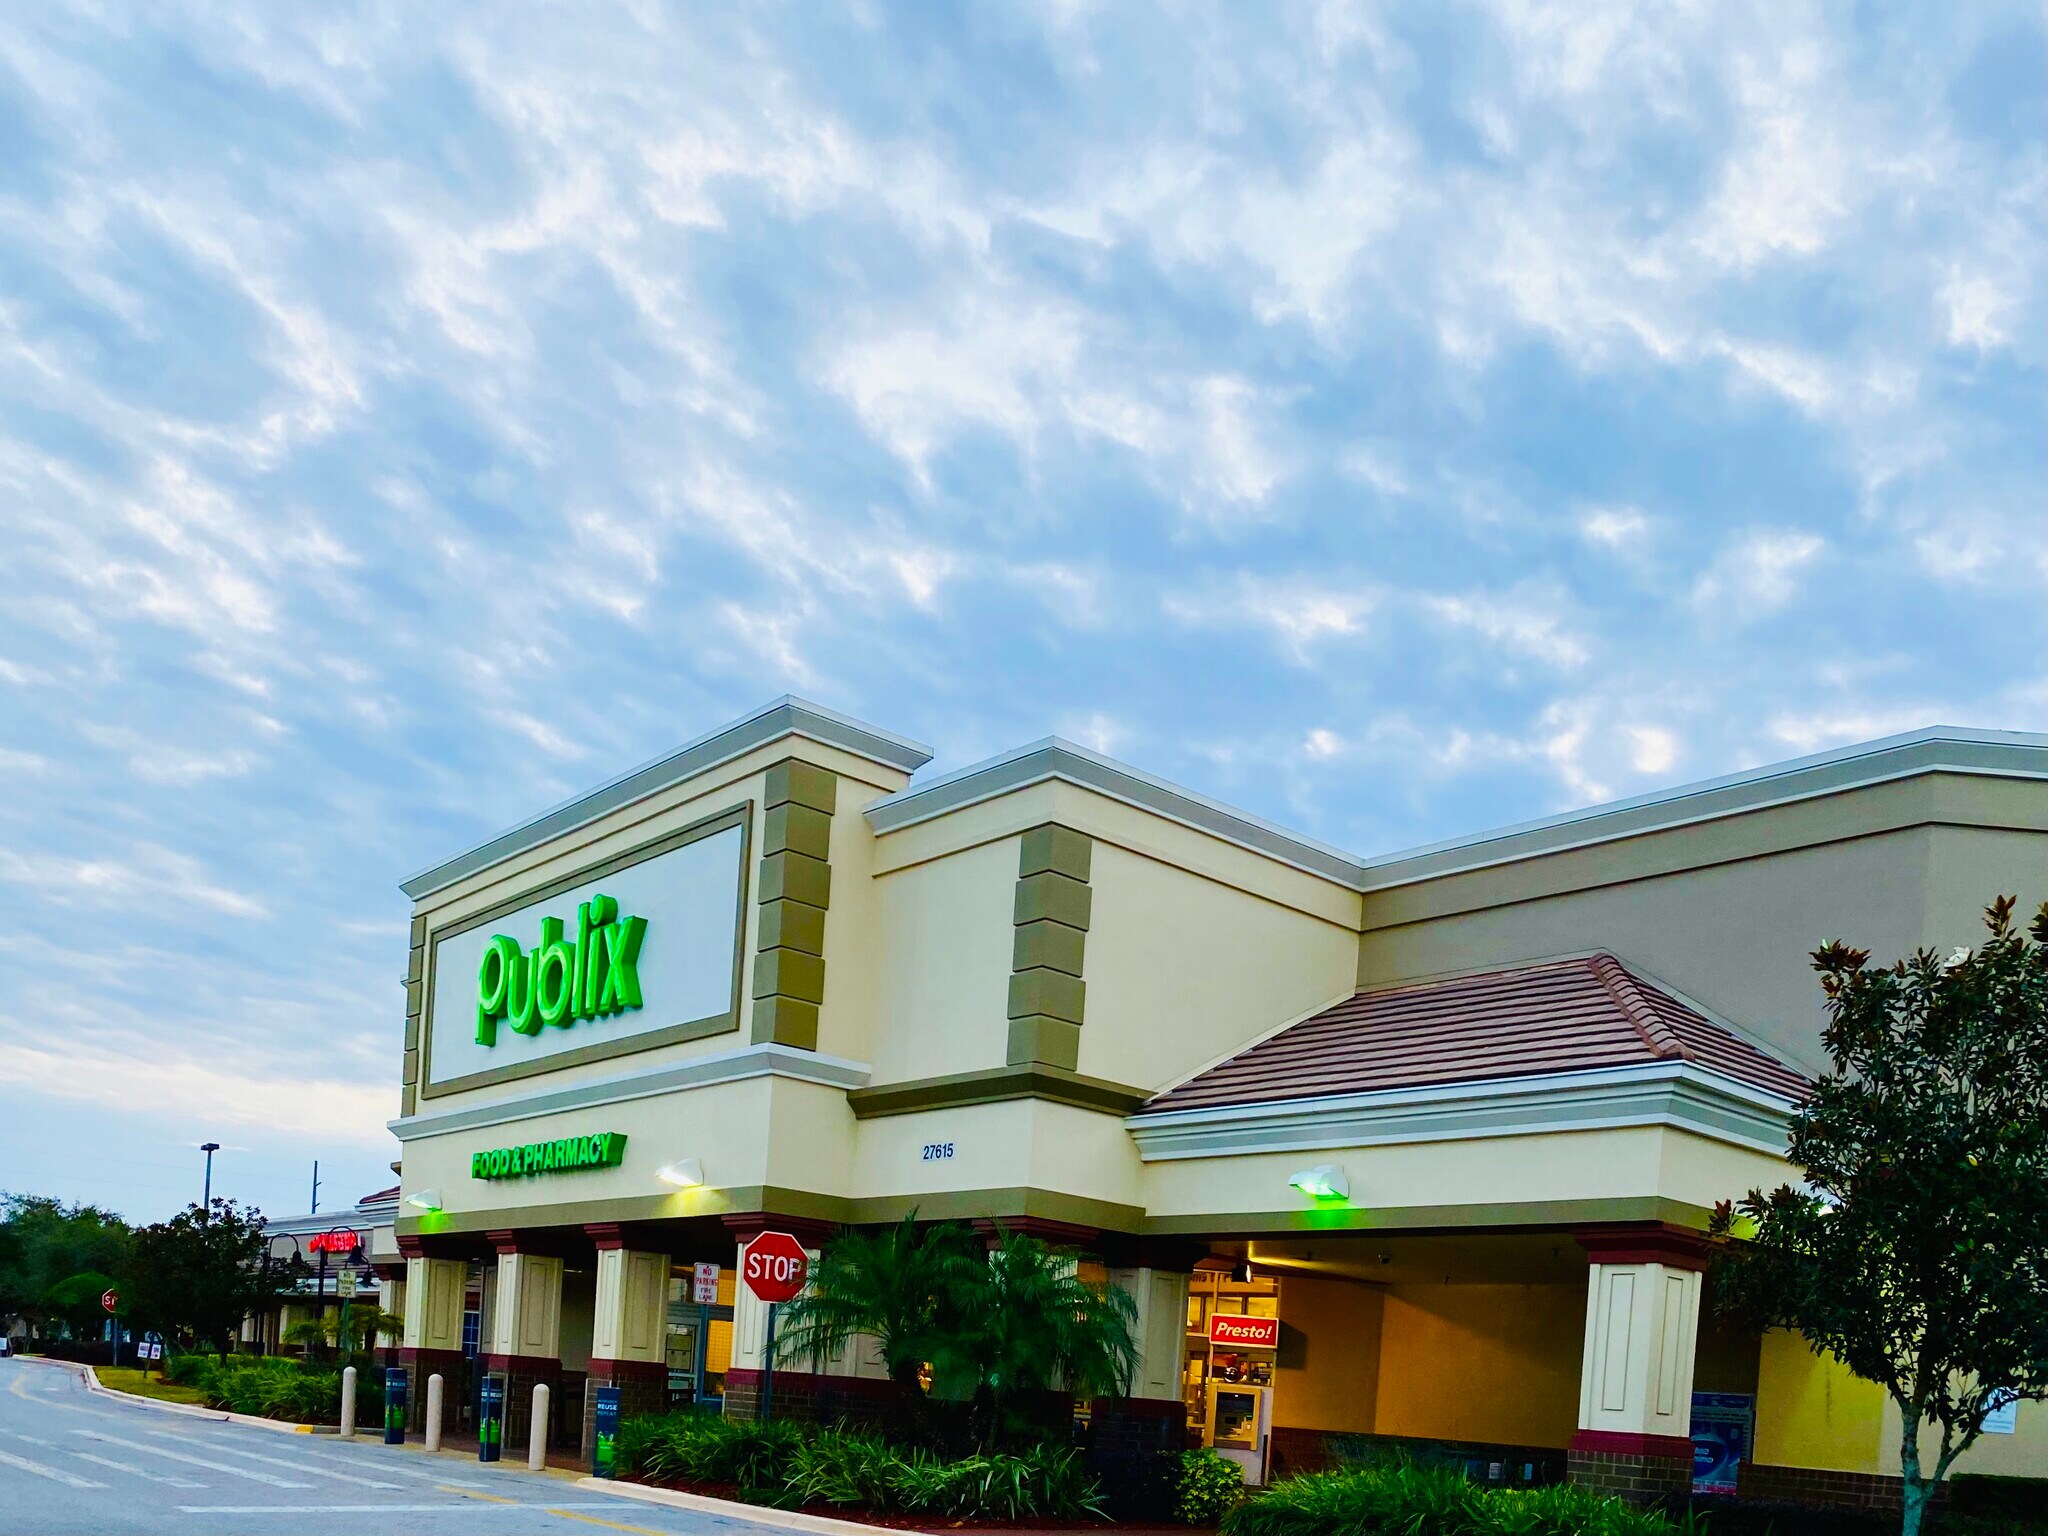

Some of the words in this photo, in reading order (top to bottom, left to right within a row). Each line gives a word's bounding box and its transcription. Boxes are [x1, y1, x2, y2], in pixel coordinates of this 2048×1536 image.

[475, 893, 648, 1047] Publix
[472, 1149, 511, 1180] FOOD
[511, 1146, 522, 1173] &
[523, 1132, 627, 1172] PHARMACY
[923, 1143, 954, 1160] 27615
[703, 1268, 712, 1276] NO
[747, 1252, 802, 1282] STOP
[695, 1277, 718, 1286] PARKING
[1215, 1321, 1273, 1339] Presto!
[597, 1403, 618, 1411] REUSE
